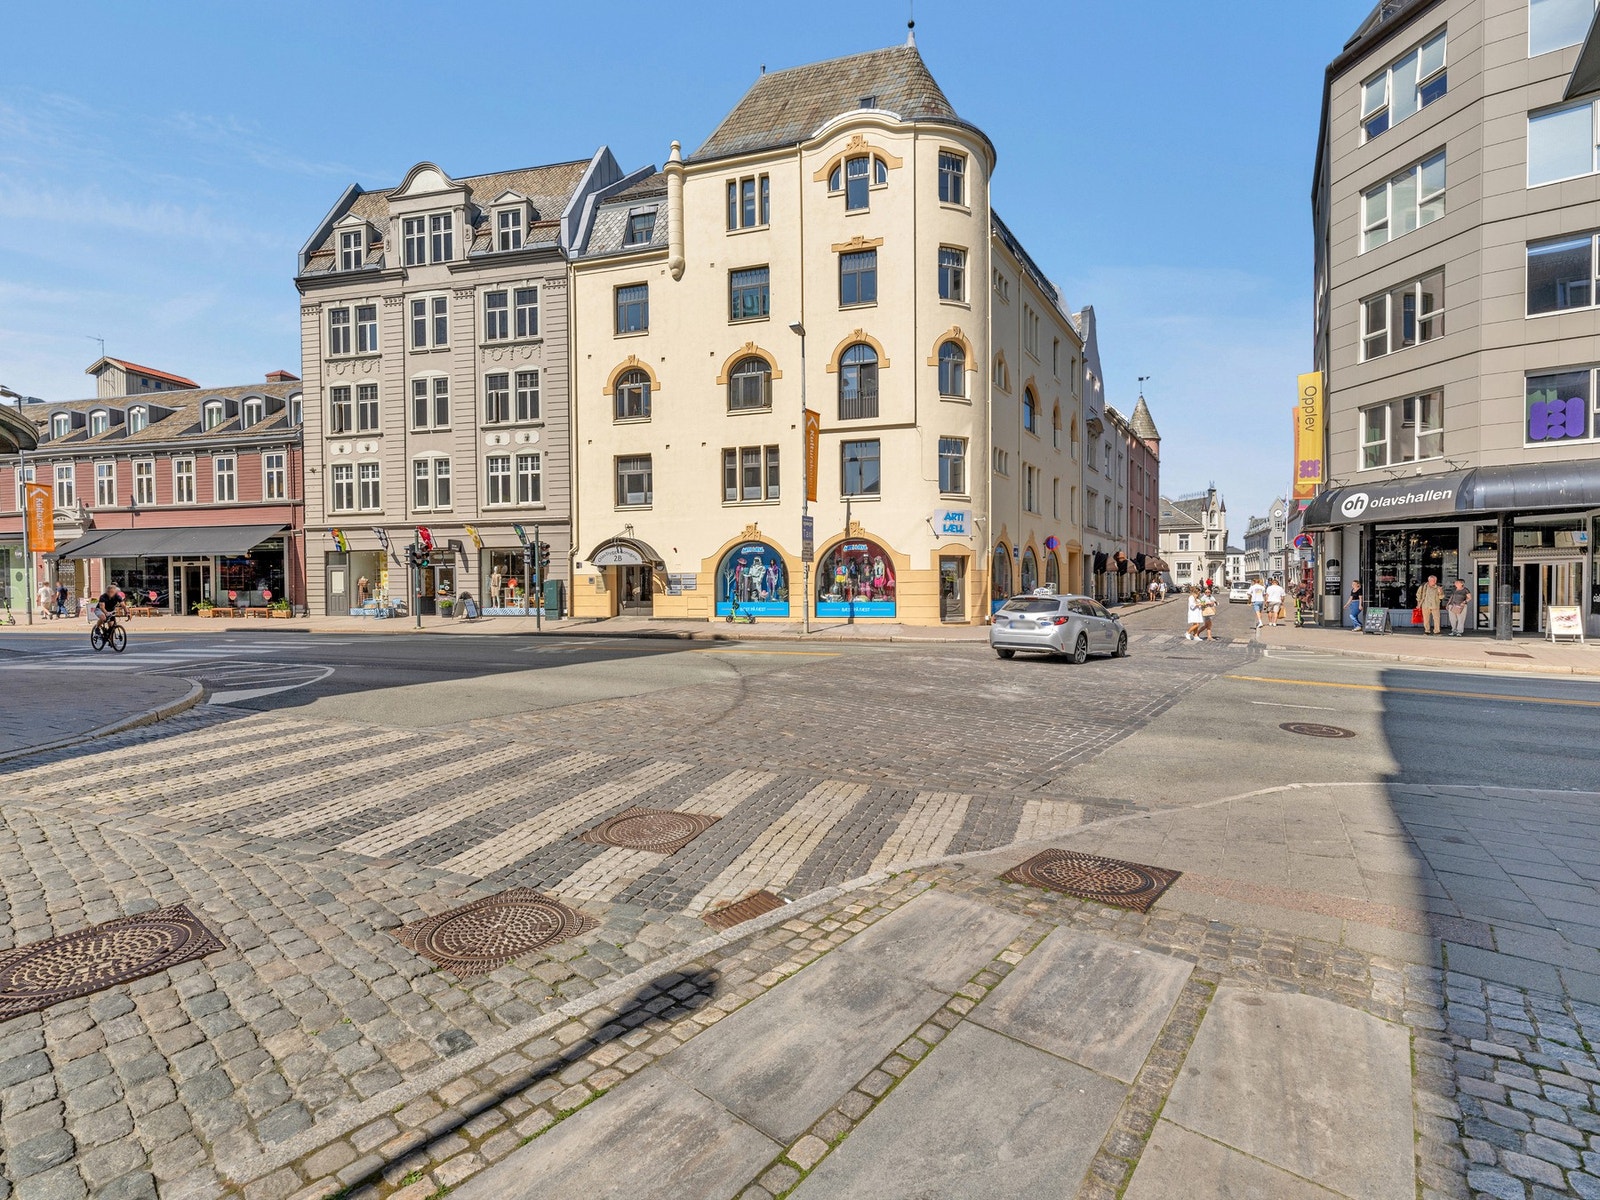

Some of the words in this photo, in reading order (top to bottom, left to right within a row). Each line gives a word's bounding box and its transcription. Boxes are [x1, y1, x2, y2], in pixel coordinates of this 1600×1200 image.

[1301, 385, 1318, 432] Opplev
[1344, 496, 1365, 511] oh
[1370, 489, 1453, 508] olavshallen
[944, 511, 964, 522] ARTI
[943, 524, 965, 533] LÆLL
